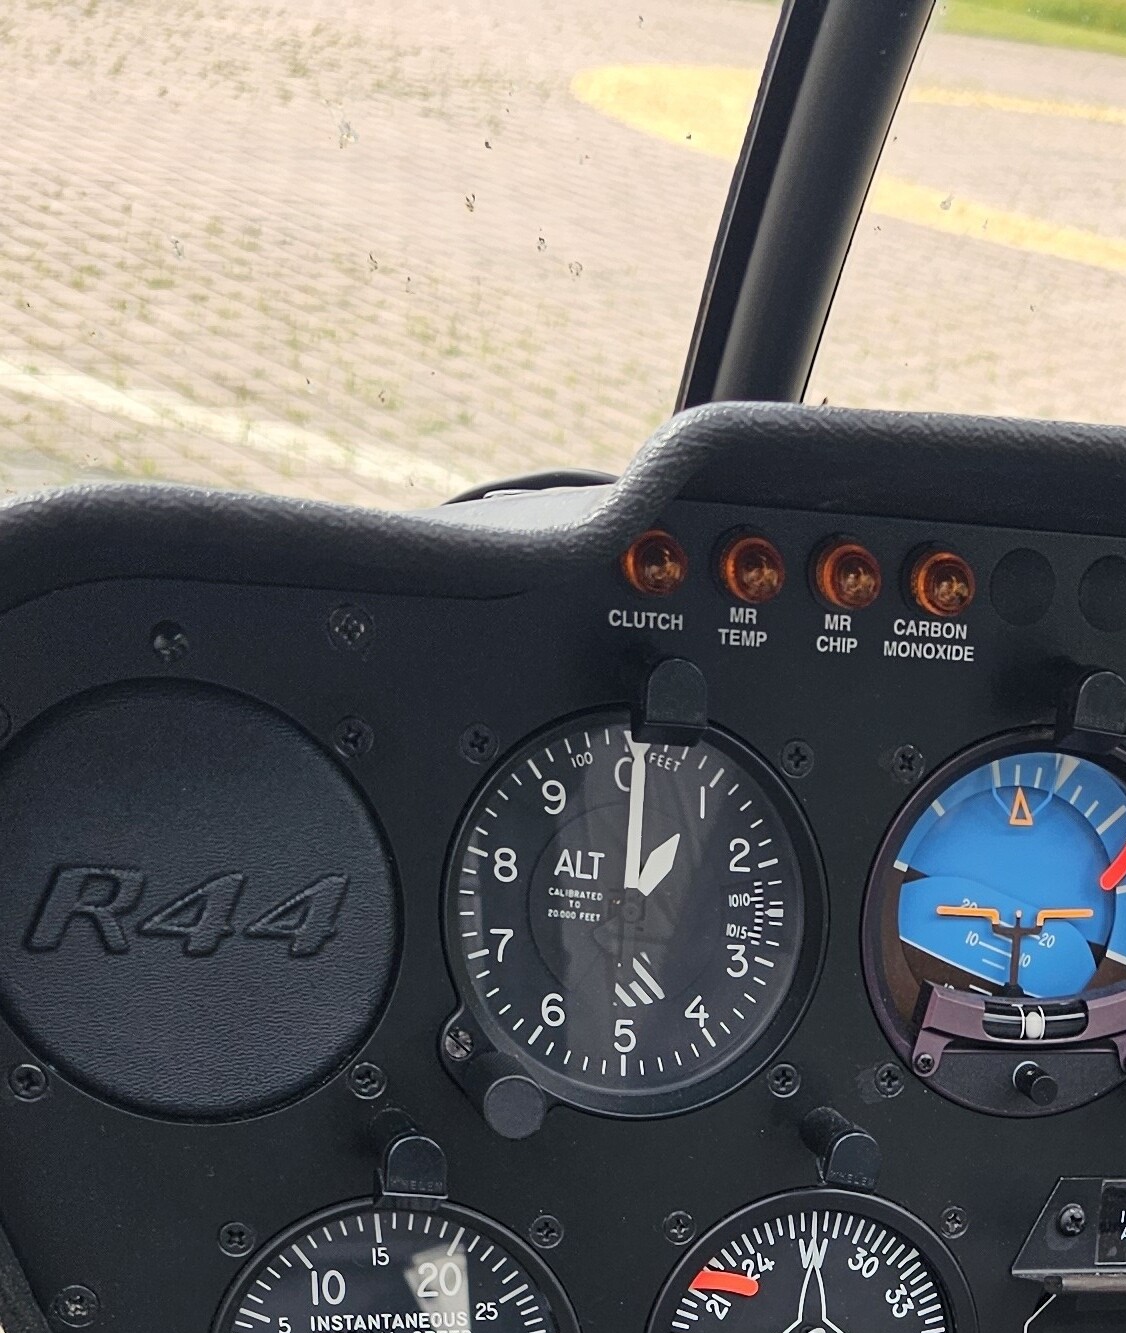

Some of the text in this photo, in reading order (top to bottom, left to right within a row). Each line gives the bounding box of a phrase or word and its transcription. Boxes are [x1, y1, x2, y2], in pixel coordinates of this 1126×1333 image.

[608, 609, 684, 630] CLUTCH
[730, 607, 757, 624] MR
[824, 614, 852, 631] MR
[718, 629, 767, 647] TEMP
[893, 619, 967, 640] CARBON
[816, 635, 858, 654] CHIP
[883, 641, 974, 662] MONOXIDE
[649, 753, 682, 772] FEET
[554, 849, 605, 880] ALT
[548, 887, 603, 901] CALIBRATED
[728, 894, 750, 907] 1010
[21, 863, 348, 958] R44
[848, 1247, 879, 1278] 30
[310, 1312, 468, 1332] INSTANTANEOUS
